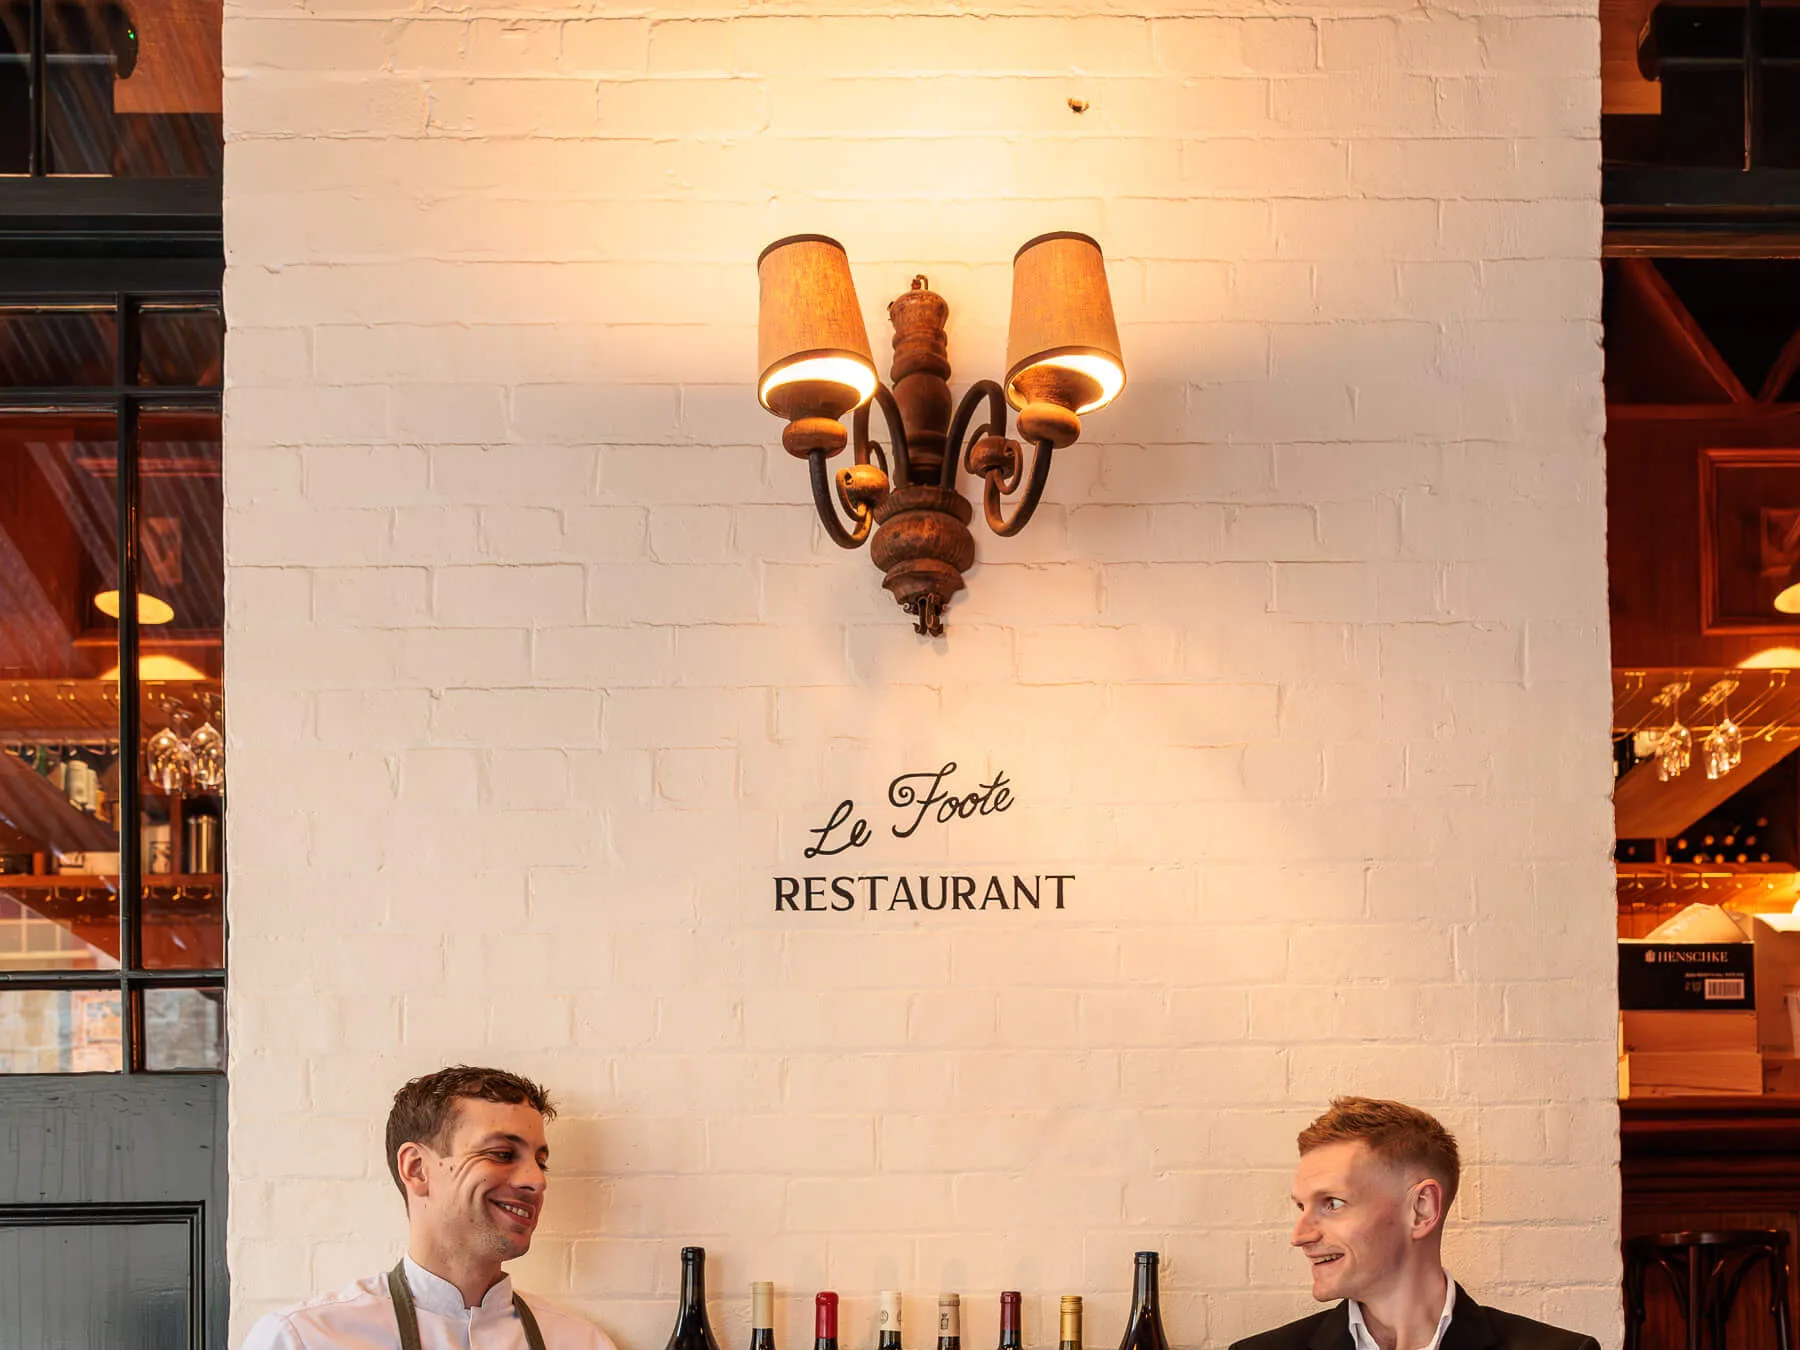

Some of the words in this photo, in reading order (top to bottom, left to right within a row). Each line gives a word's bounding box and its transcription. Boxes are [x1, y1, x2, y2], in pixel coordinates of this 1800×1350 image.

[804, 800, 872, 858] Le
[889, 762, 1014, 838] Foote
[773, 875, 1075, 911] RESTAURANT
[1658, 951, 1728, 963] HENSCHKE
